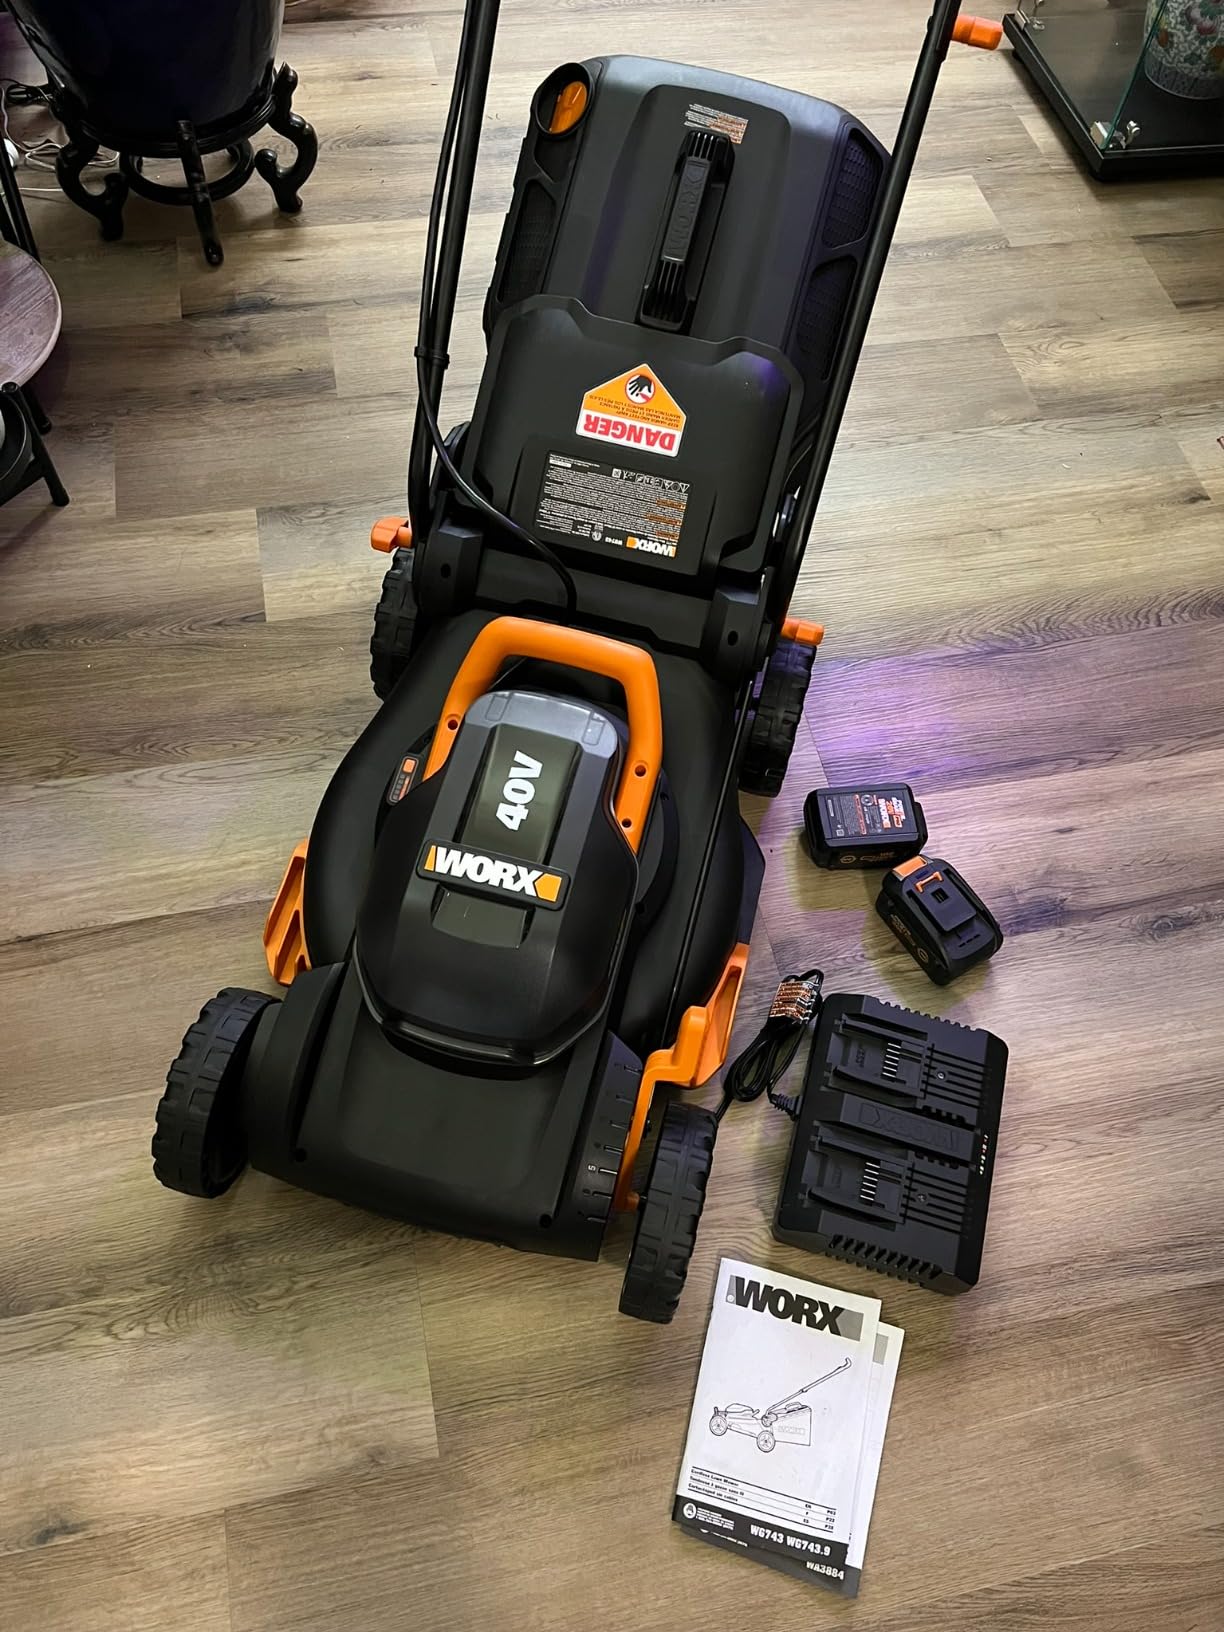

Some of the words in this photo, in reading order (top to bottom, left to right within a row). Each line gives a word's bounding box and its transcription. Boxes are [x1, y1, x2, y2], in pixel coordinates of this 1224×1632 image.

[584, 414, 676, 451] DANGER
[634, 538, 674, 557] WORX
[496, 750, 543, 831] 40V
[434, 846, 543, 897] WORX
[735, 1276, 844, 1337] WORX
[750, 1524, 784, 1544] WG743
[786, 1535, 831, 1557] WG743.9
[806, 1561, 845, 1581] WA3884
